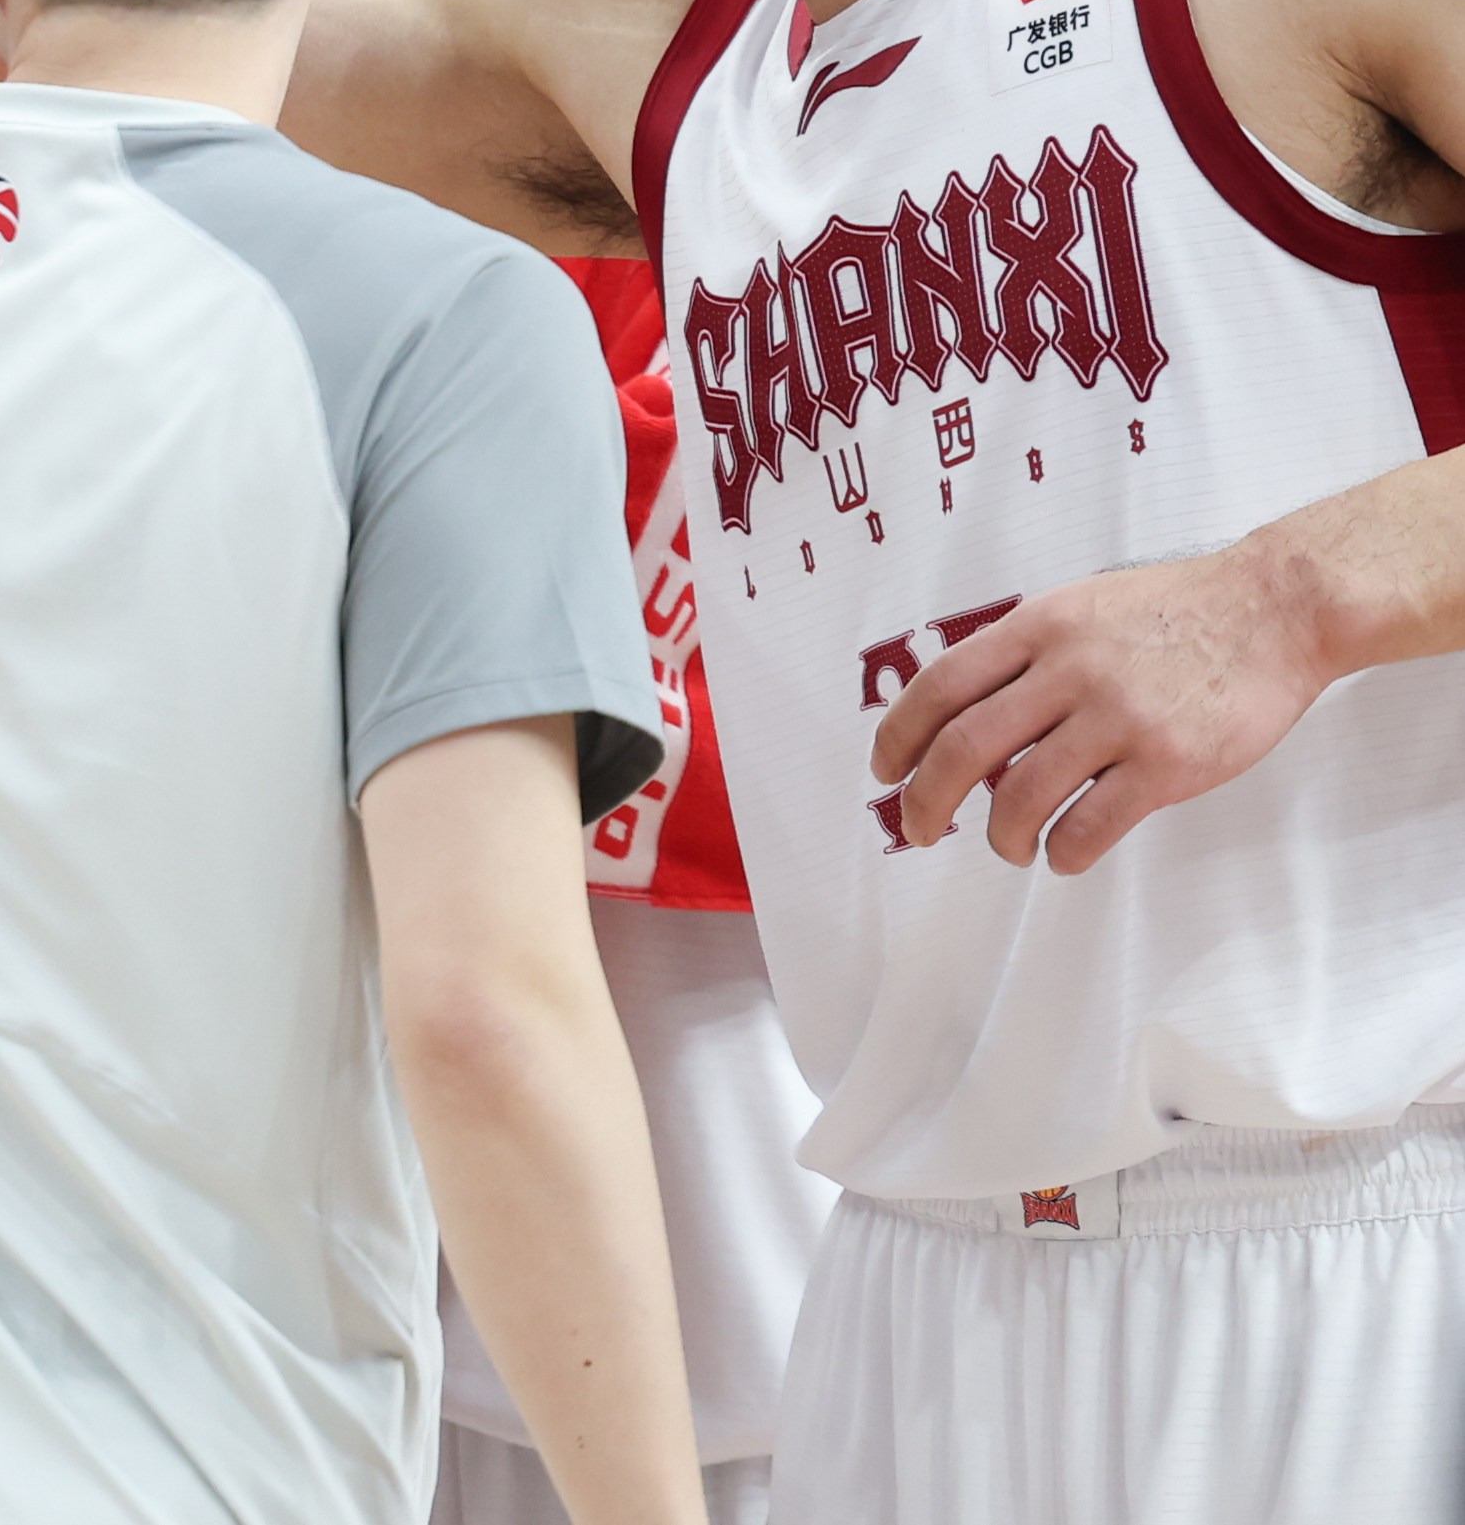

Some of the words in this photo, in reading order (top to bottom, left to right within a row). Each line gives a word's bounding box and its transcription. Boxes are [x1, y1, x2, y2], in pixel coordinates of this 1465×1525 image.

[1007, 4, 1091, 52] 广发银行
[1023, 40, 1074, 75] CGB
[683, 123, 1170, 535] SHANXI
[822, 396, 976, 514] 山西
